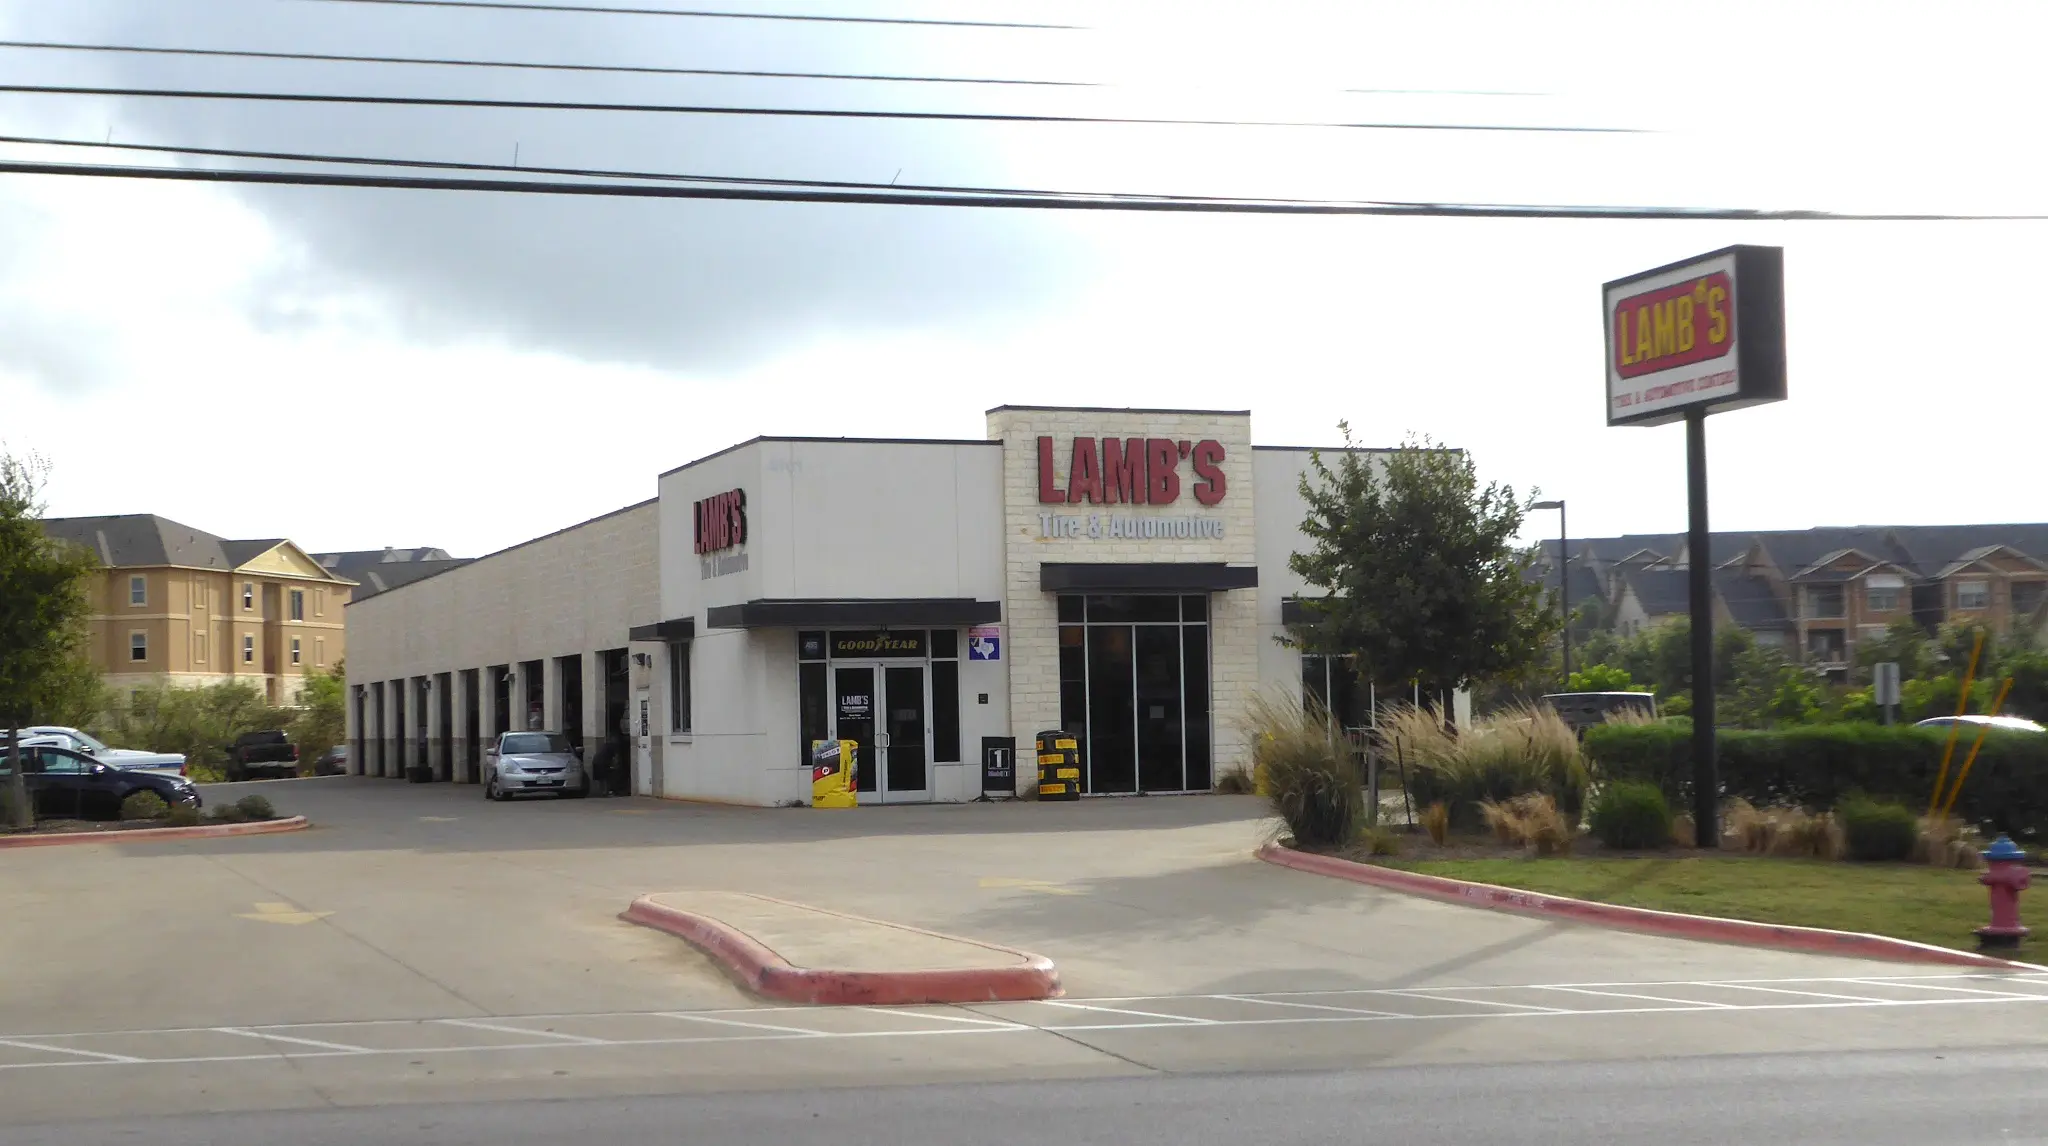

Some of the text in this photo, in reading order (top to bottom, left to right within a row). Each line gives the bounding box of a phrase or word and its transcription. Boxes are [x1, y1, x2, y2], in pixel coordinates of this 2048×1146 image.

[1620, 278, 1726, 366] LAMB'S
[1038, 436, 1227, 505] LAMB'S
[693, 488, 747, 555] LAMB'S
[1039, 512, 1225, 540] Tire & Automotive
[838, 639, 918, 651] GOODYEAR
[841, 695, 869, 705] LAMB'S
